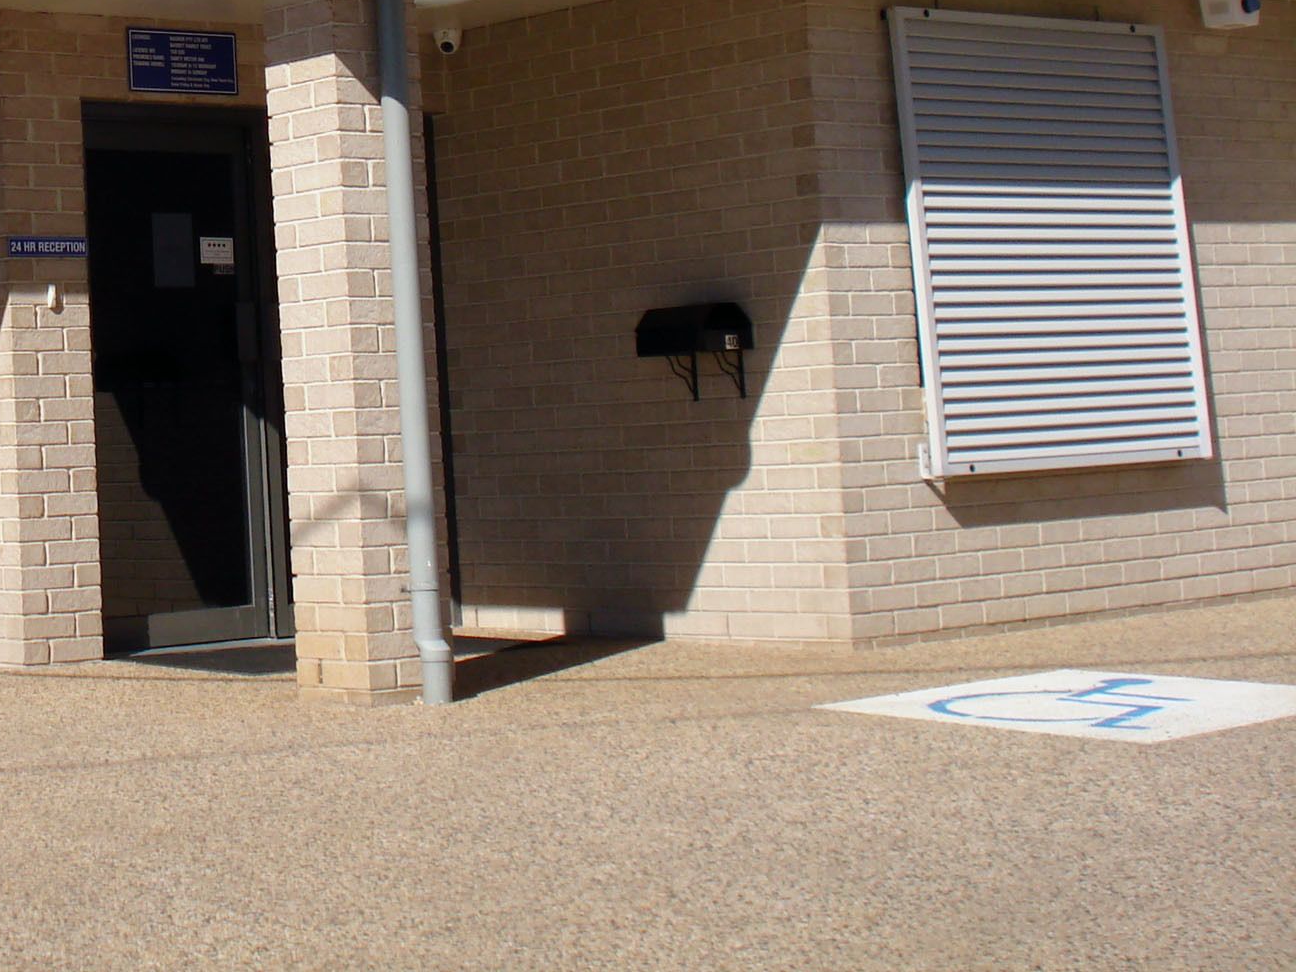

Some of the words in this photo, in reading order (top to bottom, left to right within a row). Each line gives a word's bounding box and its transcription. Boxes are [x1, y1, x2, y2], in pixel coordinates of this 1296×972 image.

[10, 241, 22, 252] 24
[24, 241, 36, 252] HR
[38, 241, 86, 253] RECEPTION
